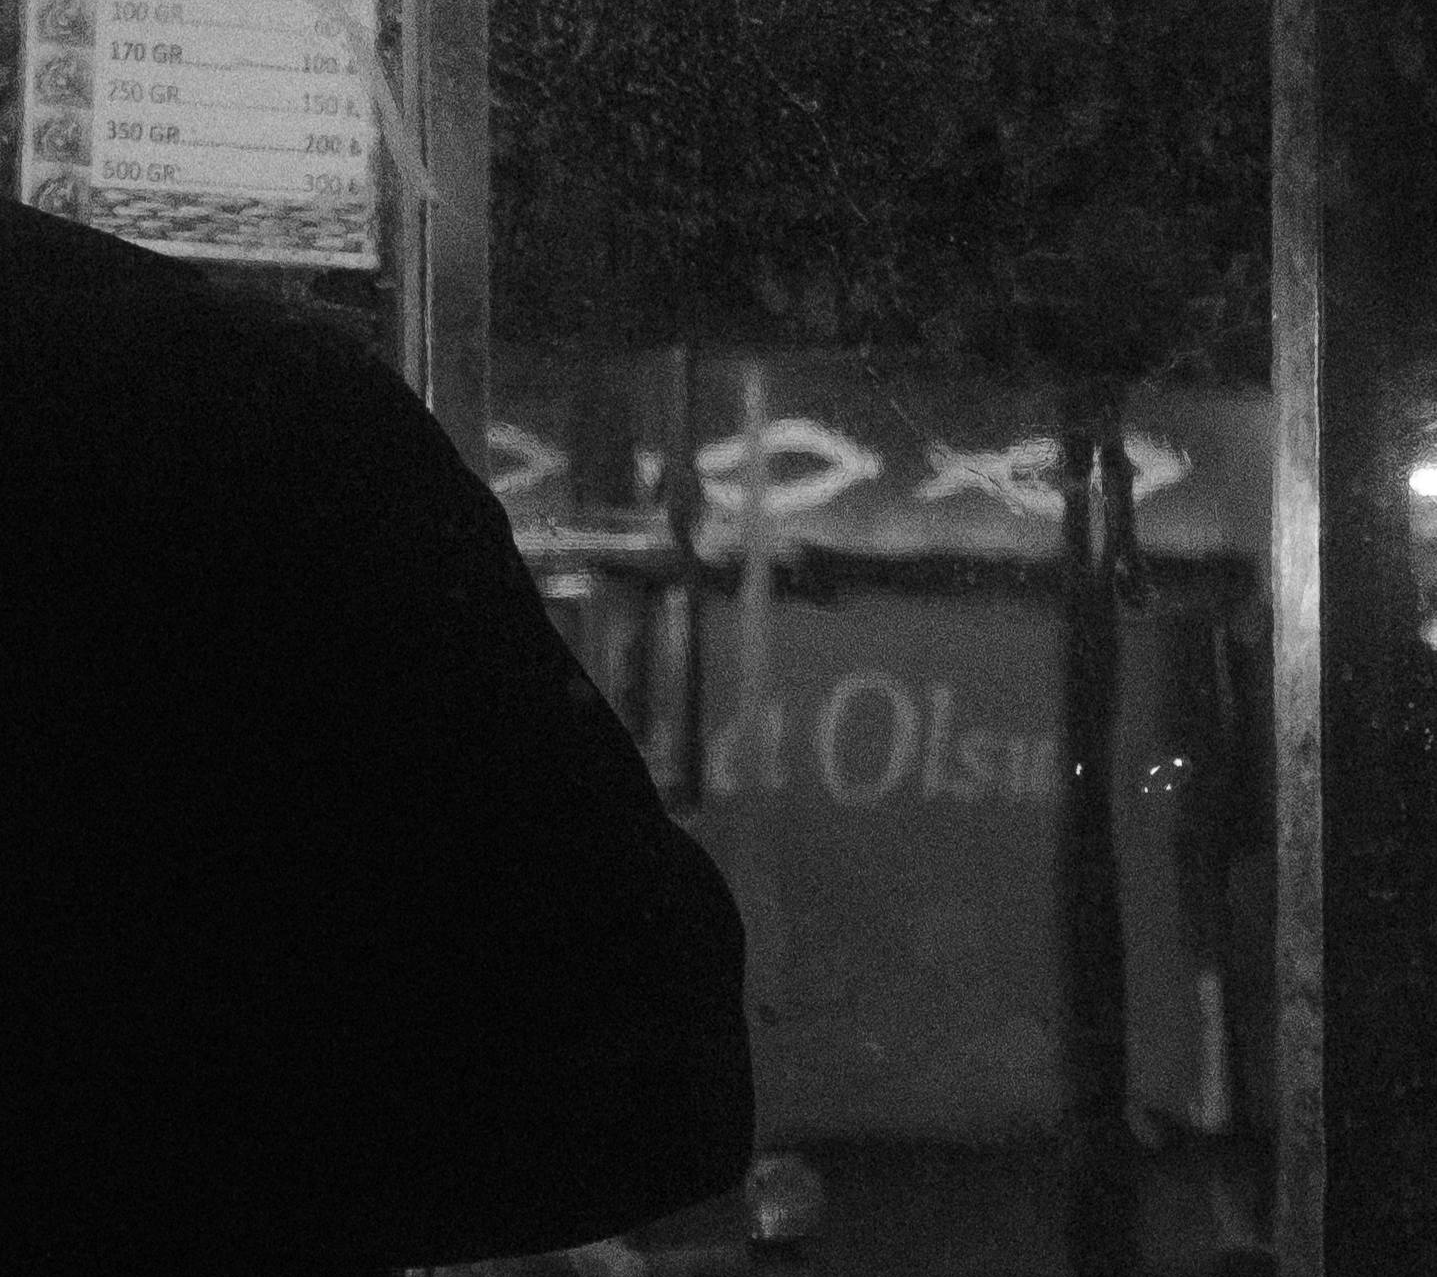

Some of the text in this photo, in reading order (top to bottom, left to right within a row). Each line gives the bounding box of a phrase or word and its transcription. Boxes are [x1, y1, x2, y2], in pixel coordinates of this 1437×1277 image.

[111, 41, 145, 61] 170
[153, 43, 183, 64] GR
[302, 53, 338, 73] 100
[149, 83, 179, 104] GR
[106, 121, 143, 142] 350
[149, 124, 179, 143] GR
[304, 134, 341, 155] 200
[102, 160, 141, 181] 500
[147, 163, 176, 182] GR
